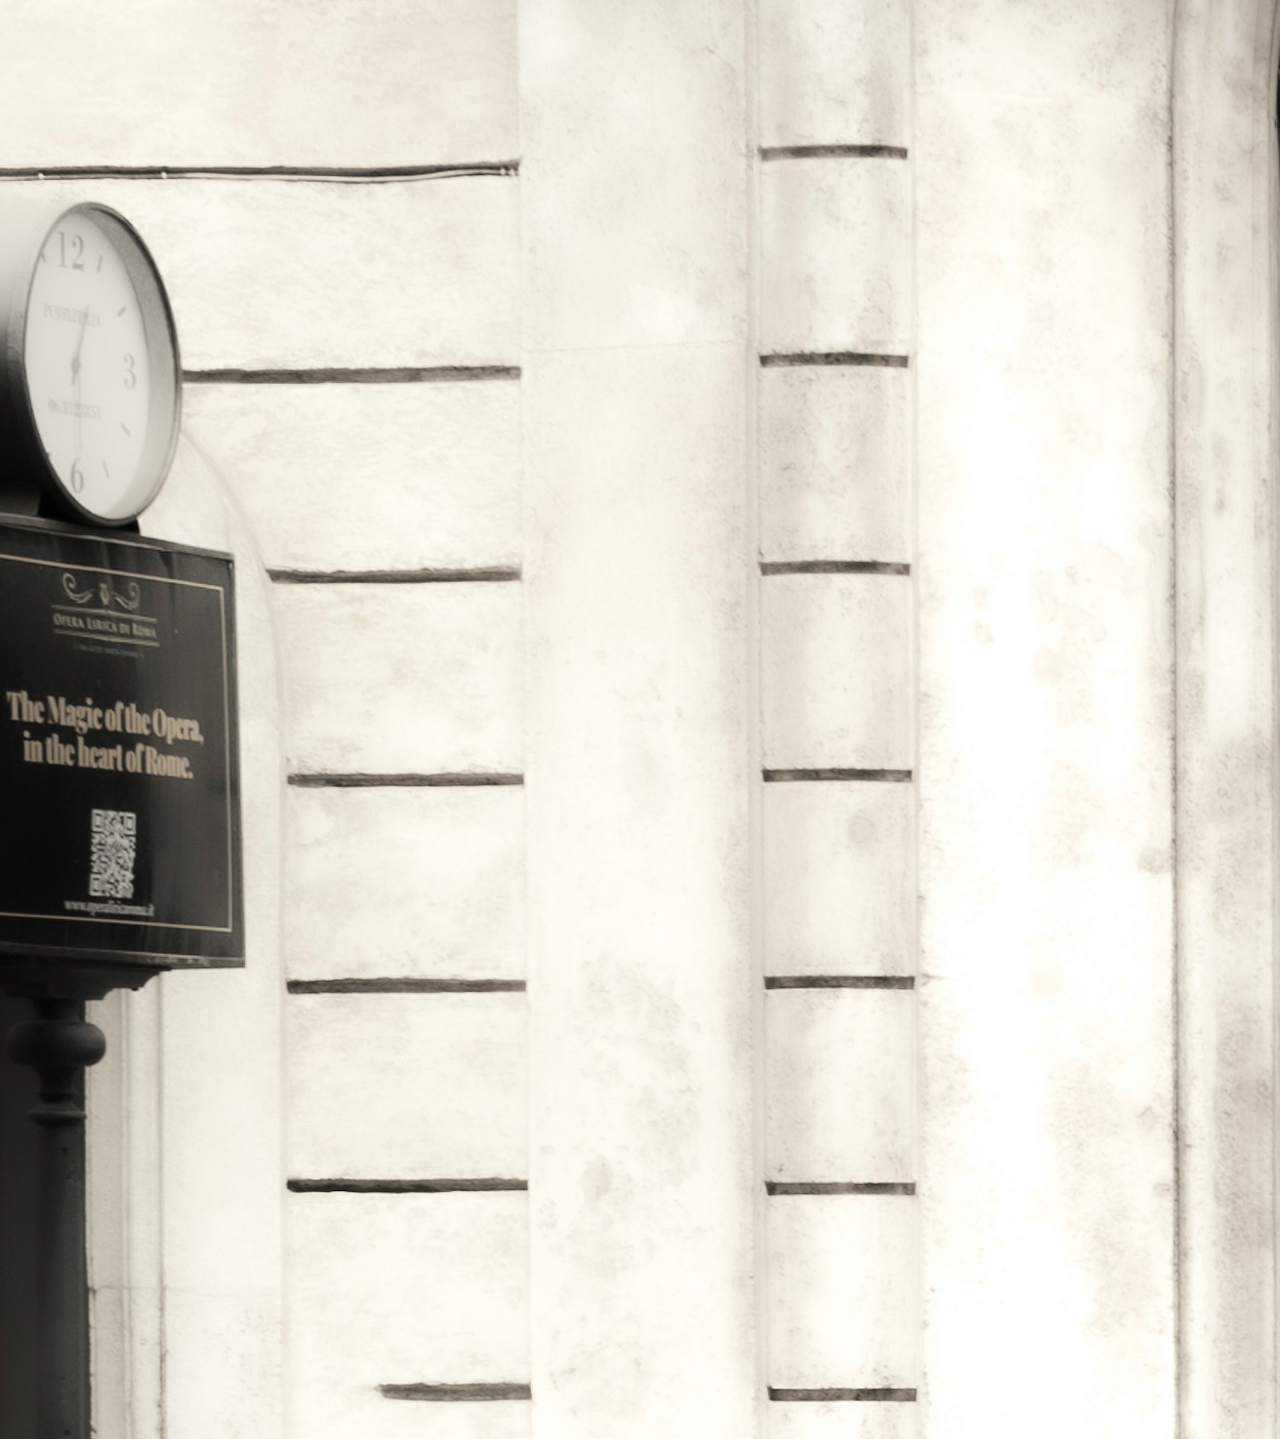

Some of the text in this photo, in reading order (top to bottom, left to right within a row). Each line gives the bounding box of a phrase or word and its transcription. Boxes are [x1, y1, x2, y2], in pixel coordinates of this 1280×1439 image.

[57, 231, 84, 271] 12
[123, 353, 137, 391] 3
[70, 457, 85, 494] 6
[6, 690, 204, 746] The Magic of the Opera,
[23, 730, 194, 779] in the heart of Rome.
